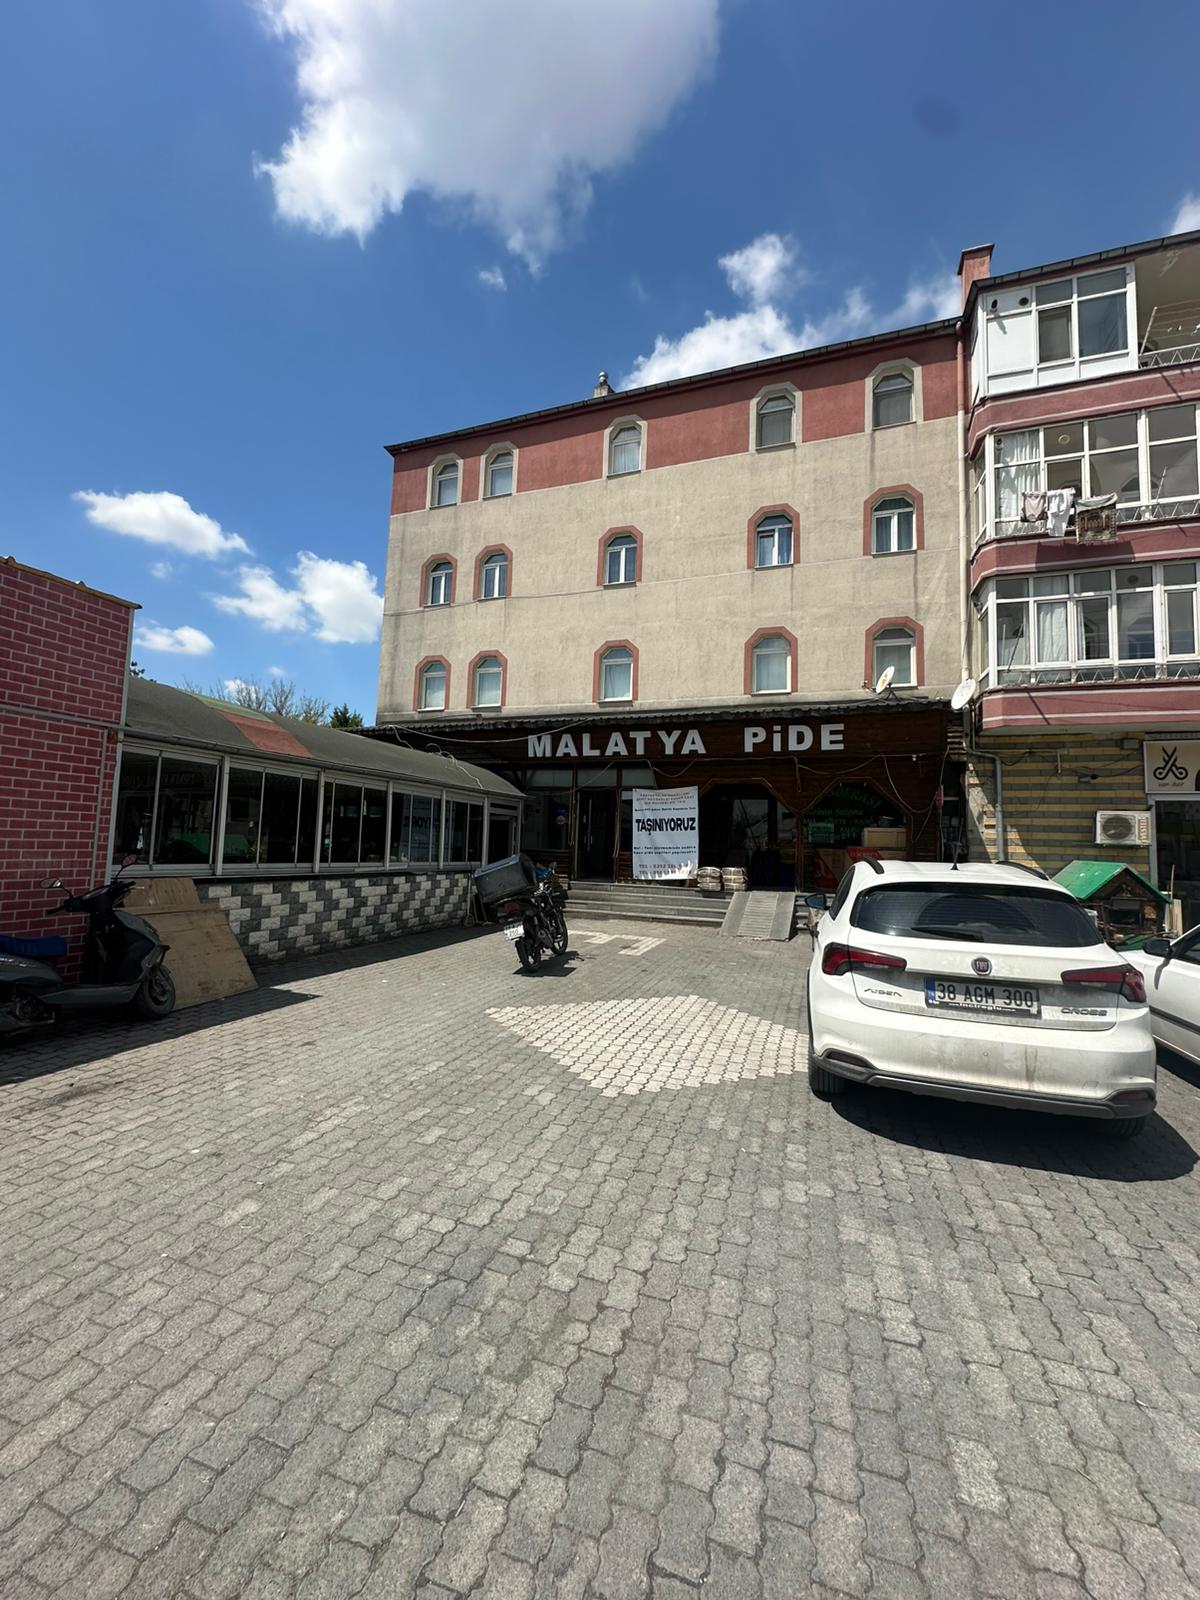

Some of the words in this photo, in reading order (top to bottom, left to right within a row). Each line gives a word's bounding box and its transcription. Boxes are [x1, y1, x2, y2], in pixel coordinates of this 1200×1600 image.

[527, 729, 707, 758] MALATYA
[635, 817, 696, 836] TAŞINIYORUZ
[937, 983, 956, 1000] 38
[963, 985, 996, 1005] AGM
[1002, 989, 1034, 1008] 300
